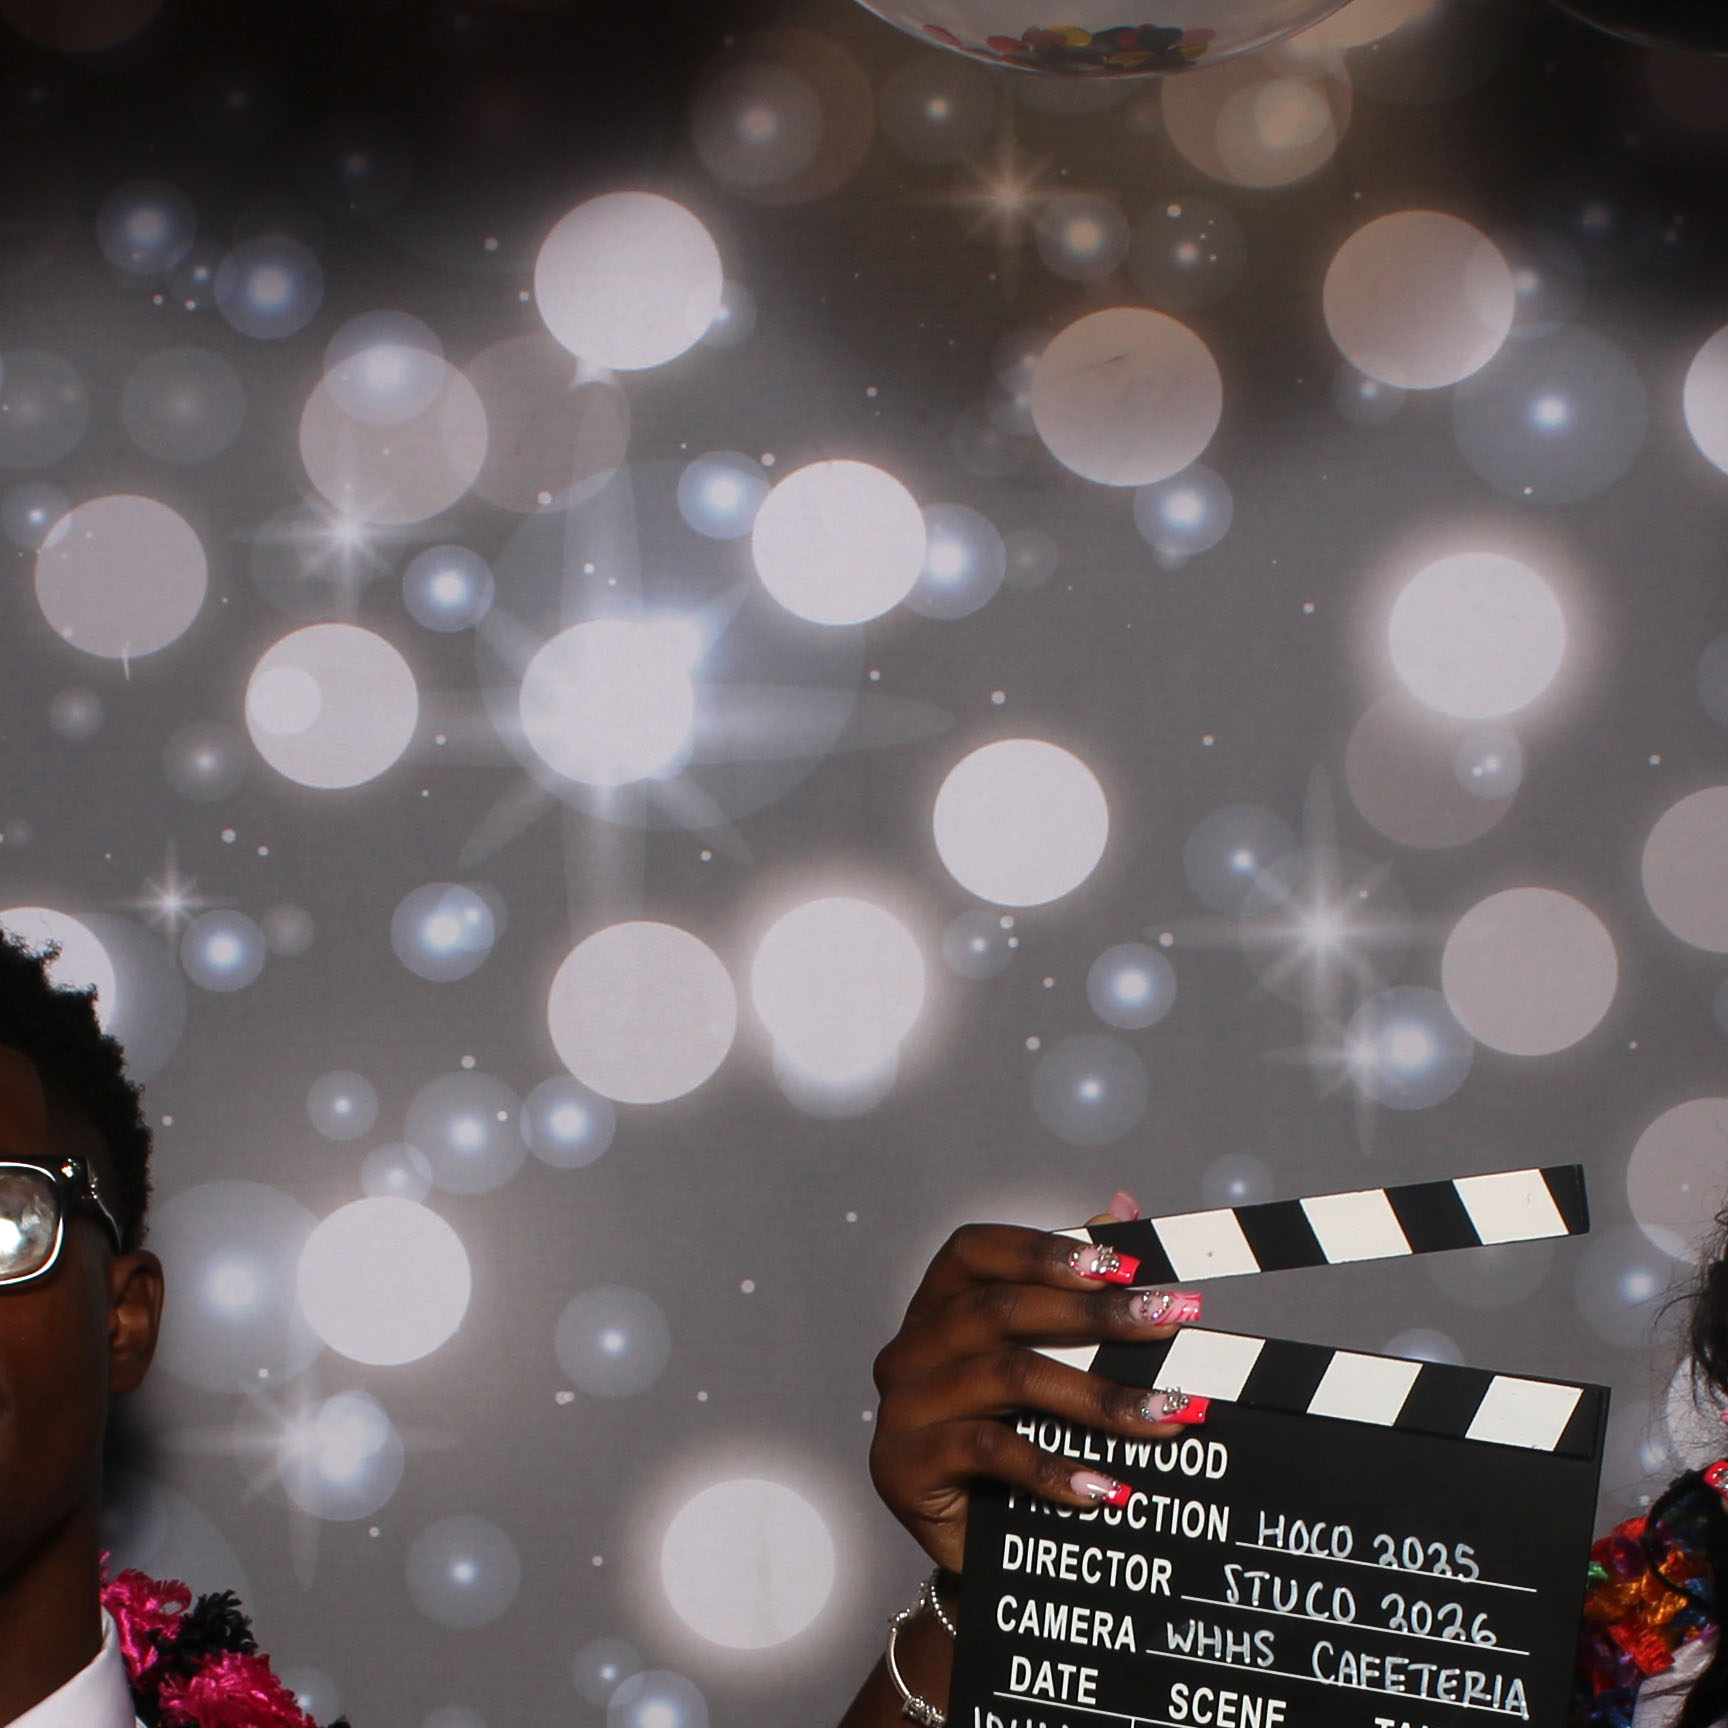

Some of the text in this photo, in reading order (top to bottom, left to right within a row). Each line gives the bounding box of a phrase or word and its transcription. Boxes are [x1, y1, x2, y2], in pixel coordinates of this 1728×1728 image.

[1002, 1533, 1172, 1597] DIRECTOR
[1257, 1510, 1480, 1582] HOCO 2025
[996, 1594, 1136, 1653] CAMERA
[1224, 1563, 1497, 1647] STUCO 2026
[1009, 1655, 1099, 1705] DATE
[1166, 1618, 1530, 1721] WHHS CAFETERIA
